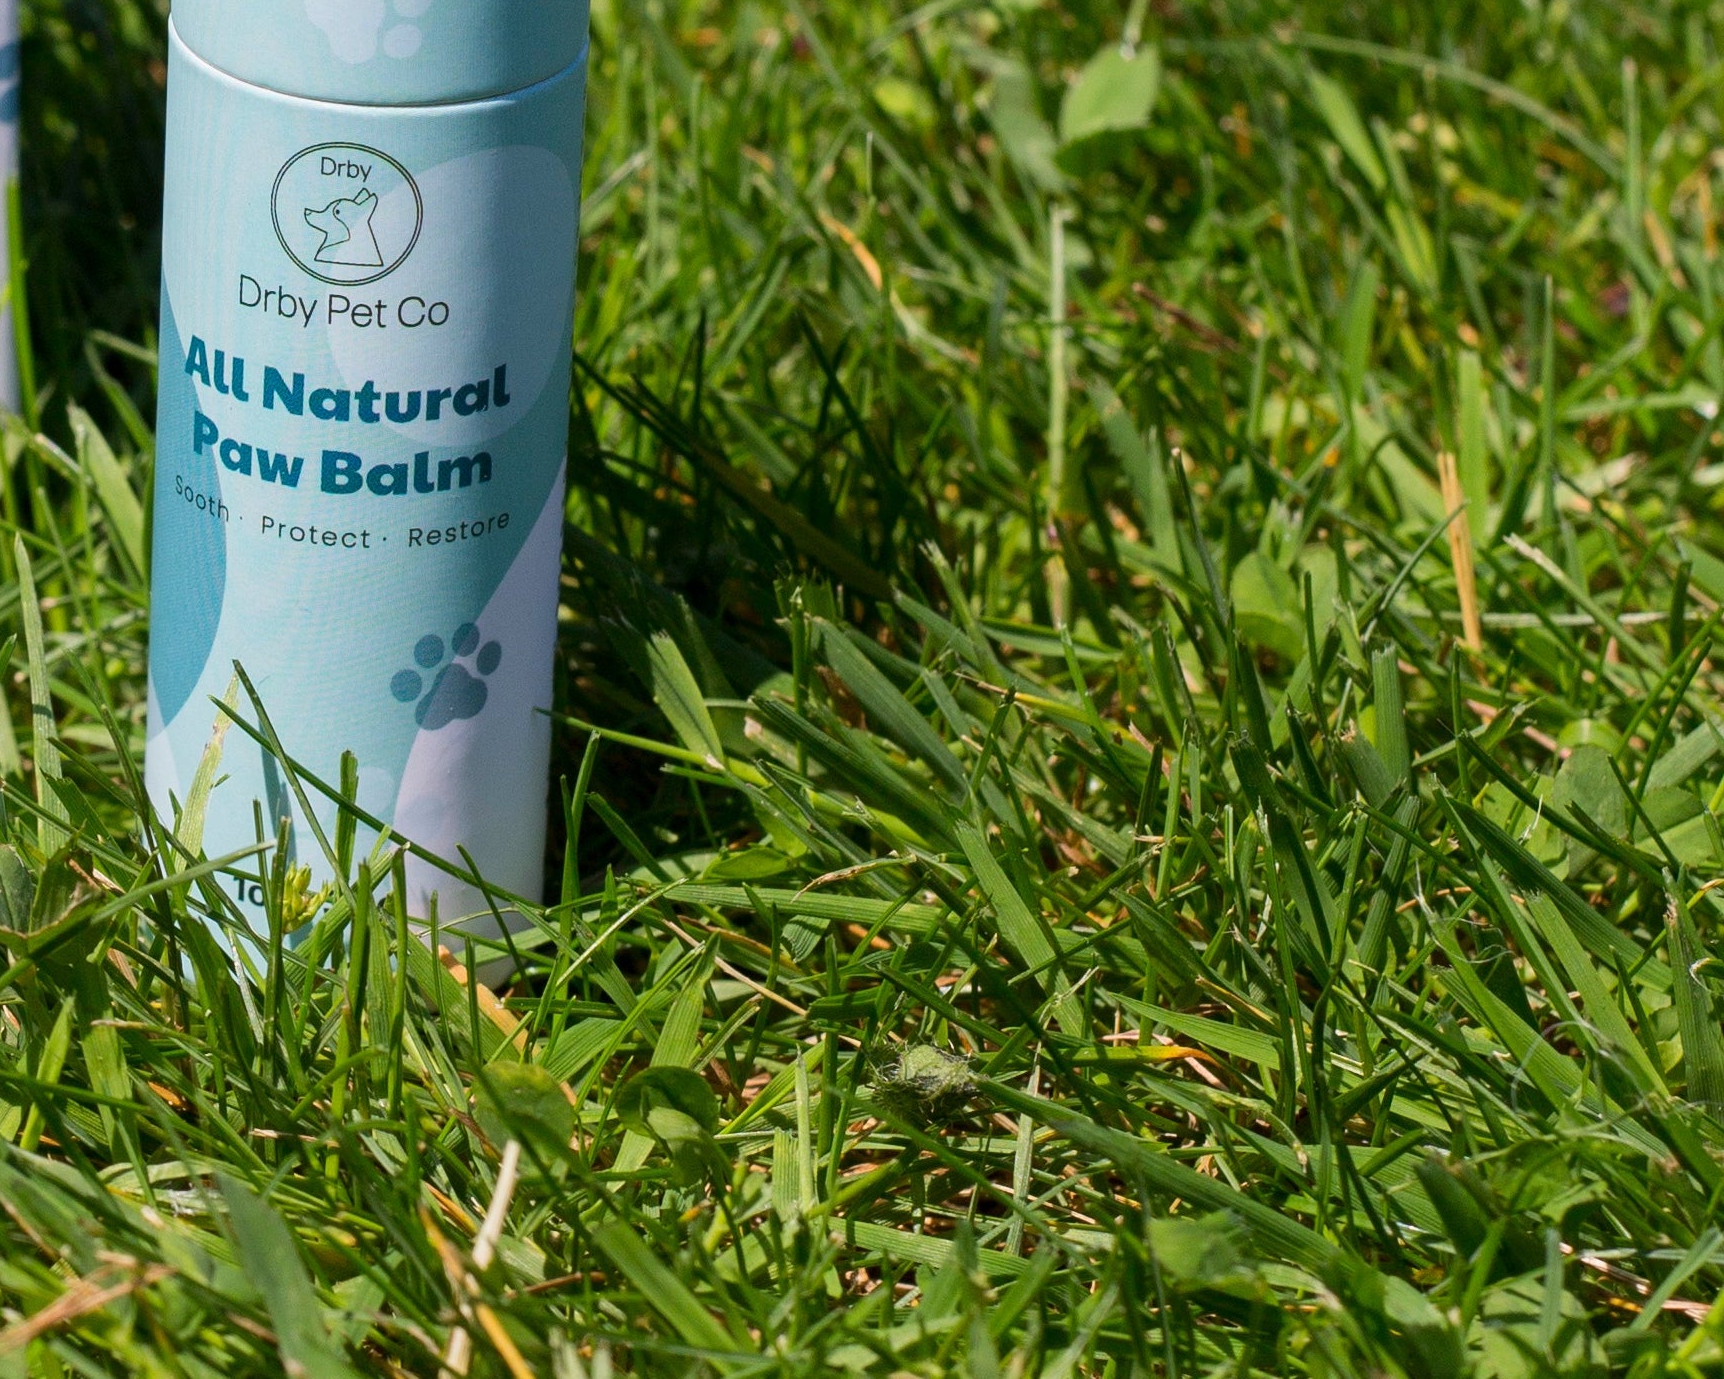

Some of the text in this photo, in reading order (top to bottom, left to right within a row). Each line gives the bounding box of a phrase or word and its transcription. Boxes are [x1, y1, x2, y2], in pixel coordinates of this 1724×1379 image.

[320, 156, 372, 183] Drby
[238, 273, 450, 329] Drby Pet Co
[184, 334, 511, 423] All Natural
[192, 410, 493, 496] Paw Balm
[175, 474, 511, 549] Sooth Protect Restore
